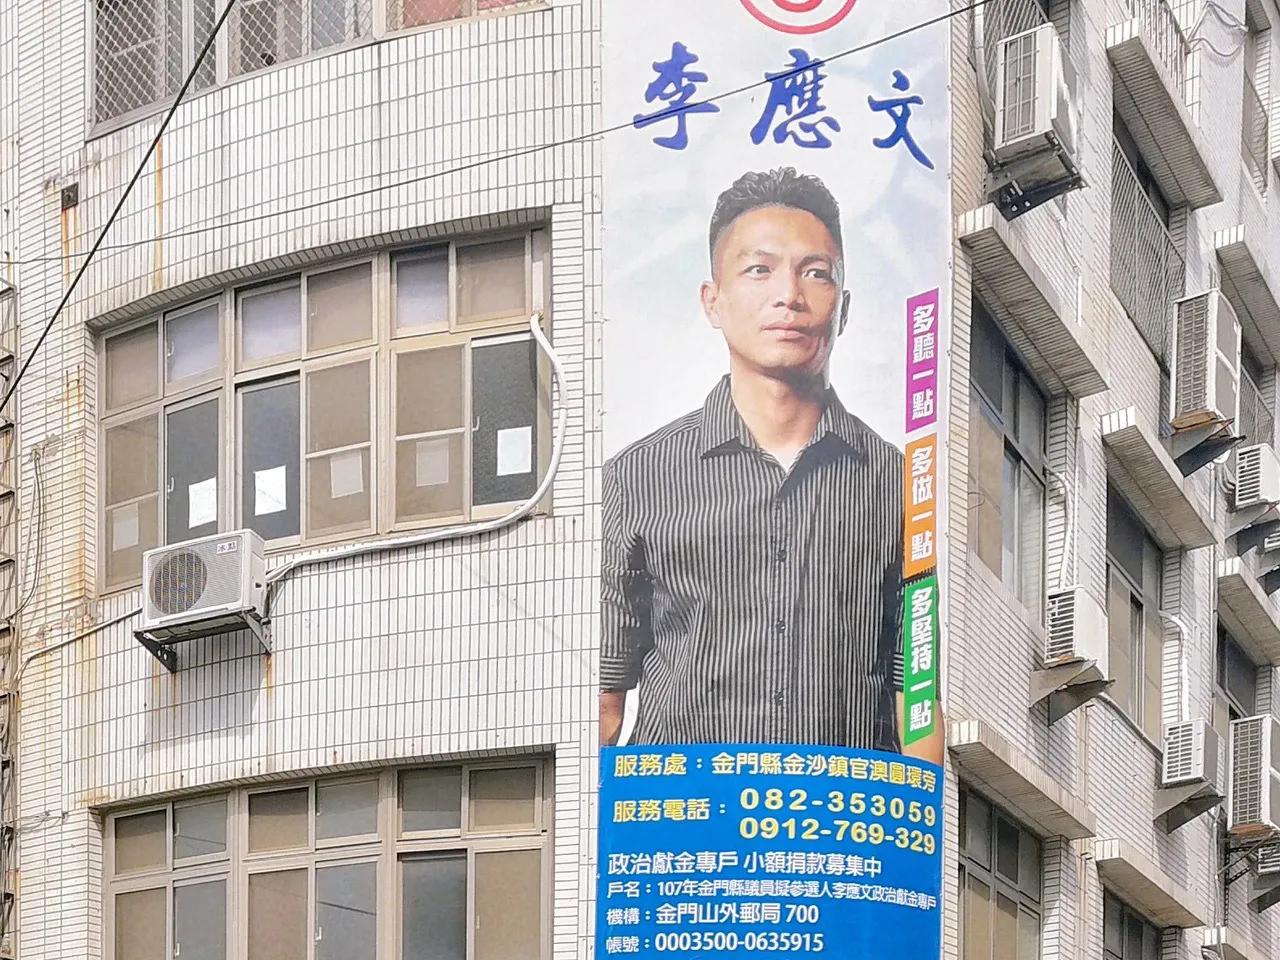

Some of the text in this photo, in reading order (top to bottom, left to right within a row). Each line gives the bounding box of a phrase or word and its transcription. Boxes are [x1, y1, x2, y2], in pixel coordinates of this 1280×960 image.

[633, 41, 934, 170] 李應文
[911, 303, 934, 422] 多聽一點
[911, 443, 933, 560] 多做一點
[910, 585, 933, 744] 多堅持一點
[739, 817, 936, 855] 0912-769-329
[740, 788, 937, 827] 082-353059
[608, 852, 882, 876] 政治獻金專戶 小額捐款募集中
[786, 905, 819, 923] 700
